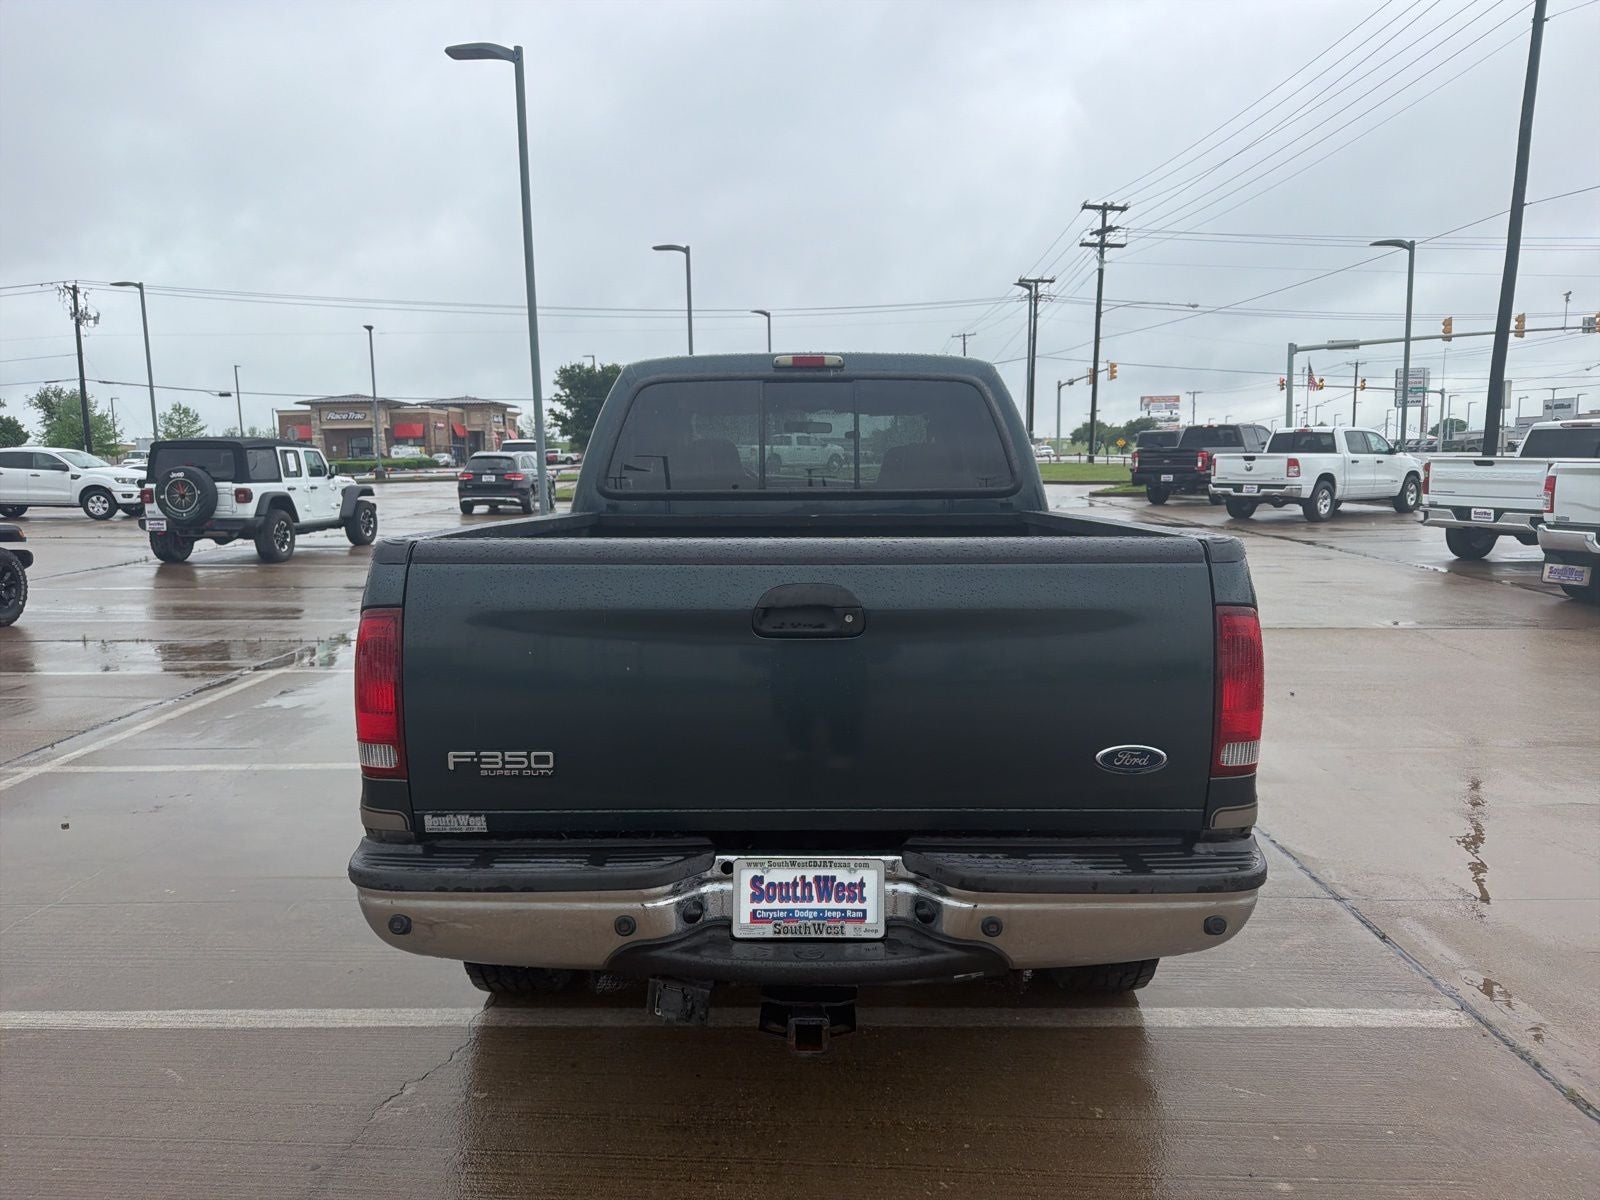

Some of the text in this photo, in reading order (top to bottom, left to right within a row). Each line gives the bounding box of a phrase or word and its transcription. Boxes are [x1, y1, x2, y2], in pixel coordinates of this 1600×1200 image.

[326, 411, 367, 421] RaceTrac
[1113, 750, 1150, 765] Ford
[424, 814, 487, 826] SouthWest
[749, 874, 867, 904] SouthWest
[756, 909, 863, 919] Chrysler Dodge Jeep Ram
[773, 921, 846, 936] SouthWest
